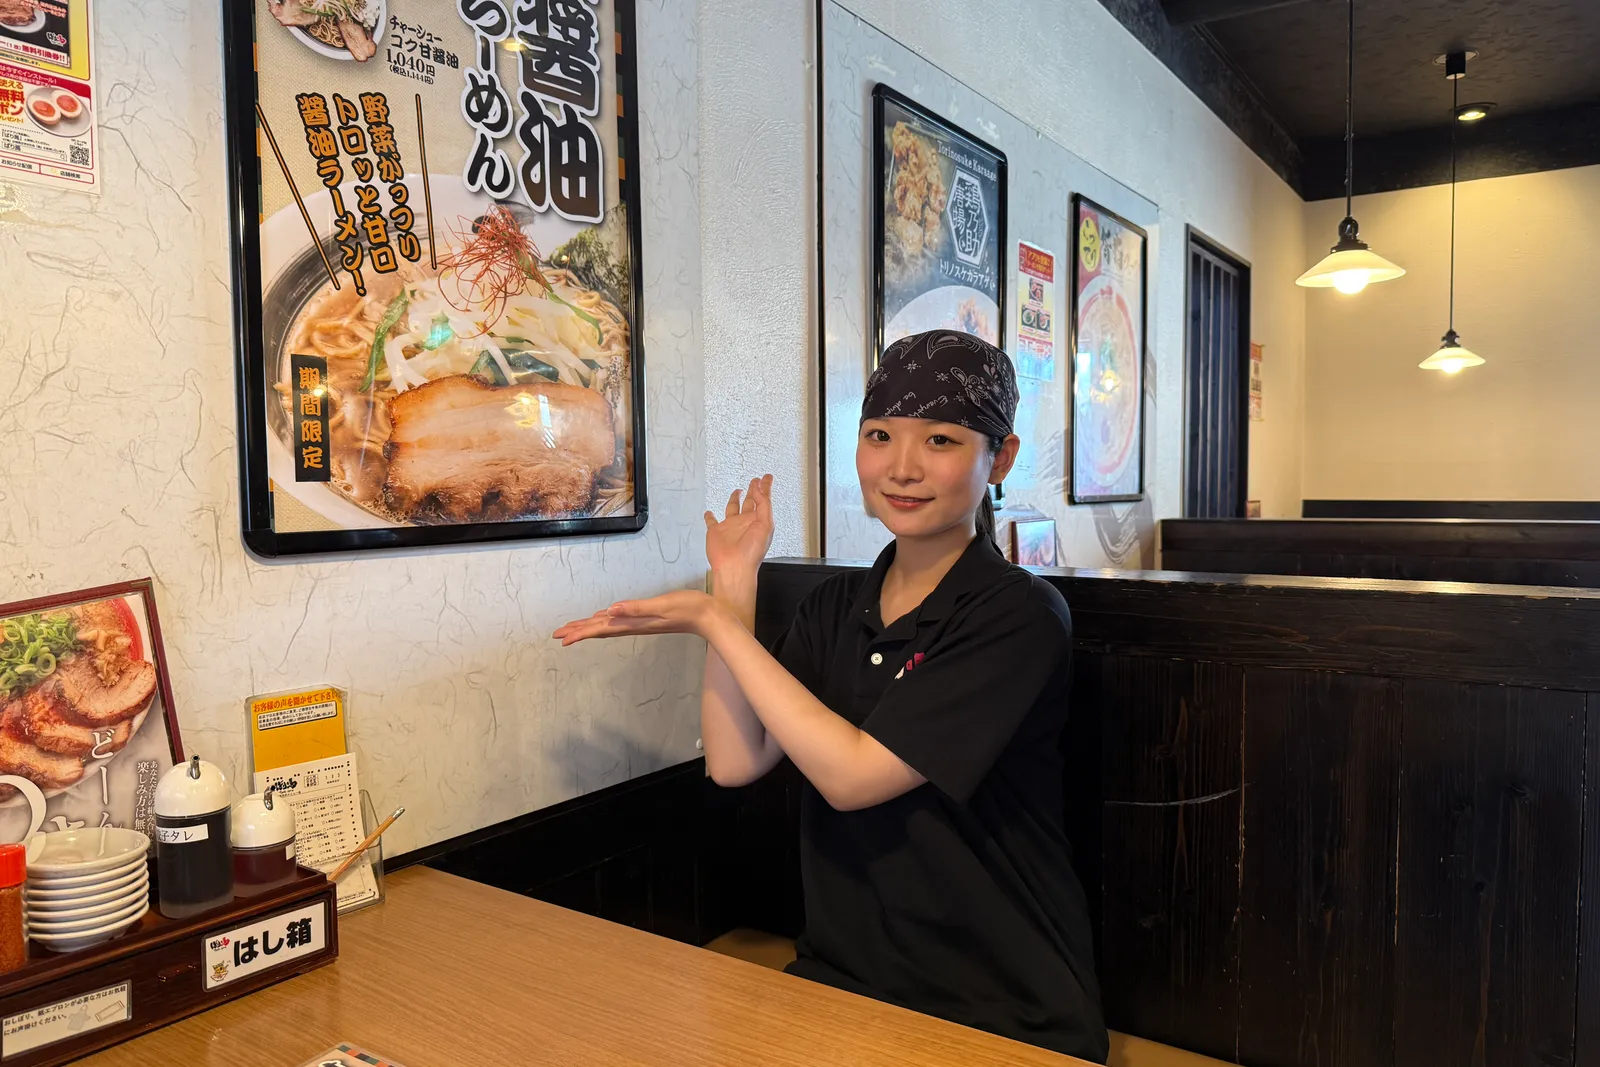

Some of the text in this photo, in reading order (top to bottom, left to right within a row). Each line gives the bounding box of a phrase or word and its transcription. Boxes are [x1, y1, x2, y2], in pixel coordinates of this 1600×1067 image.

[386, 48, 436, 78] 1,040円
[389, 15, 443, 43] チャーシュー
[391, 34, 460, 70] コク甘醤油
[295, 92, 367, 297] 醤油ラーメン!
[332, 93, 399, 274] トロッと甘口
[359, 92, 421, 262] 野菜がっつり
[299, 366, 324, 469] 期間限定
[134, 761, 150, 834] 楽しみ方は無
[233, 916, 313, 968] はし箱
